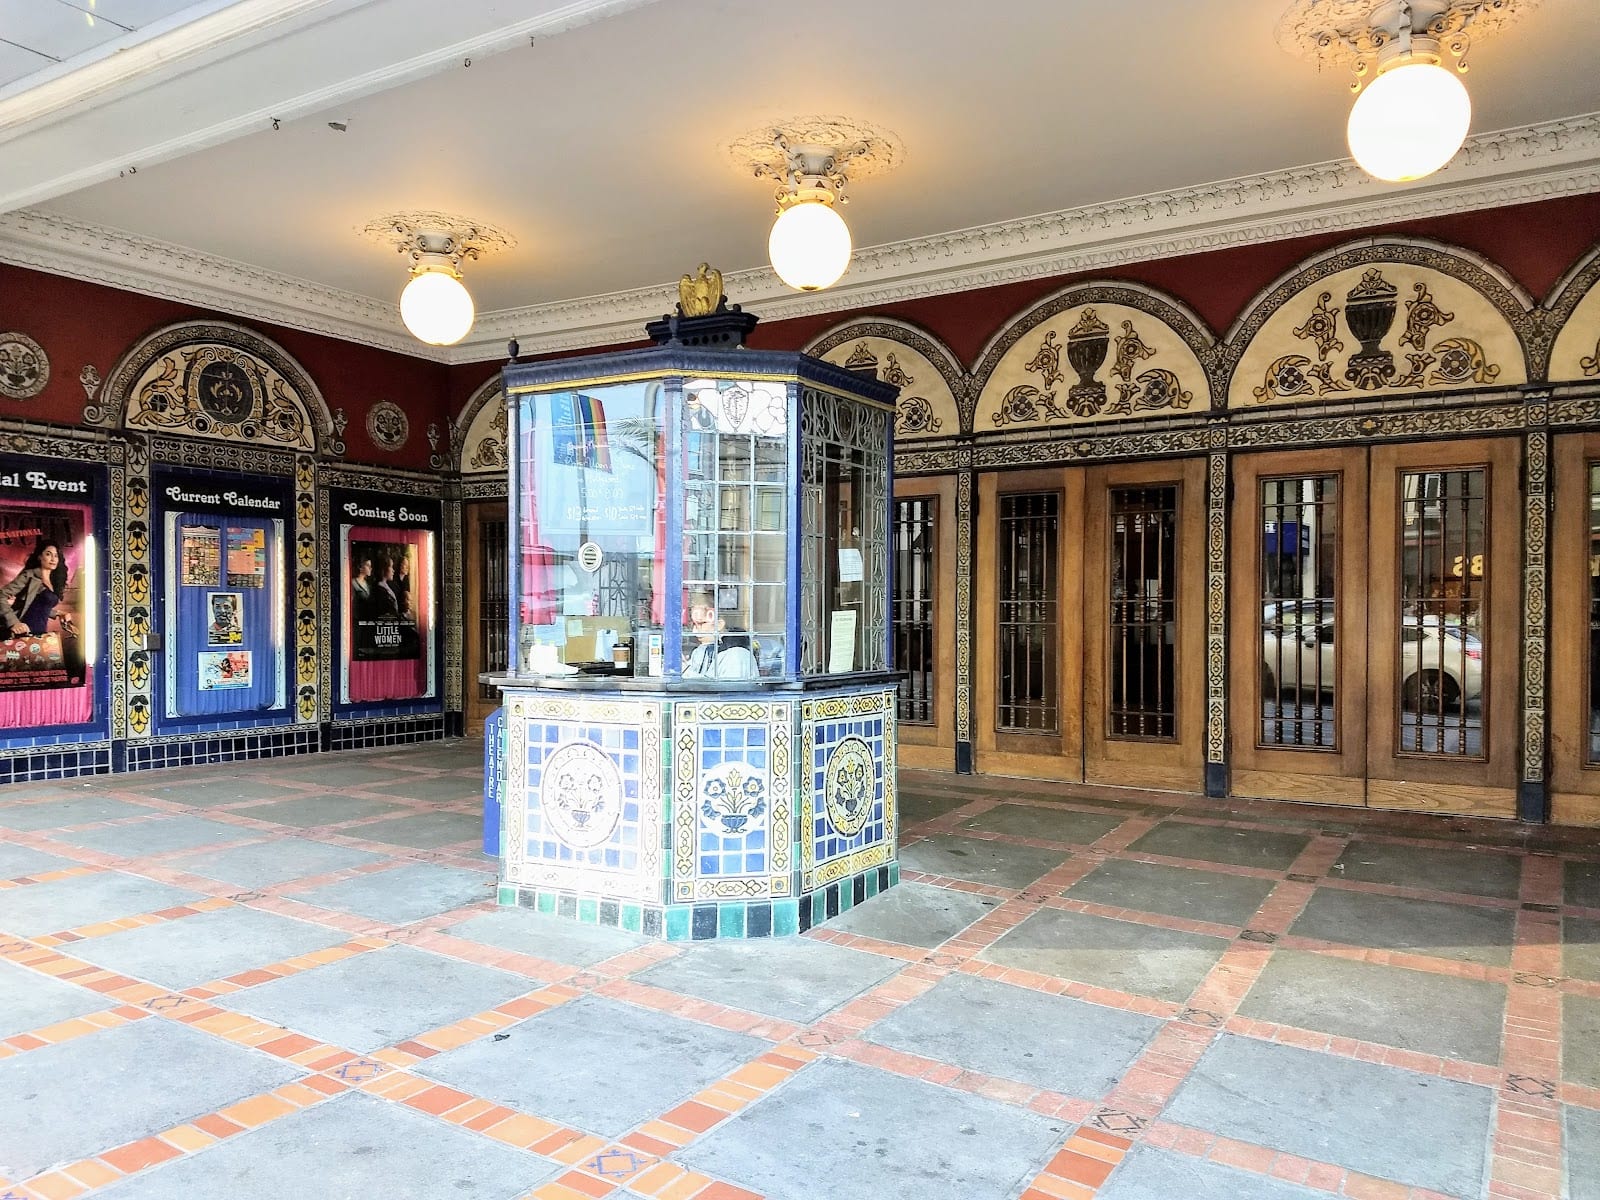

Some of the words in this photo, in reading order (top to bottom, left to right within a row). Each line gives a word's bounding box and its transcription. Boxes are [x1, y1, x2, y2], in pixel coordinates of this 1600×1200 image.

[26, 472, 87, 492] Event
[166, 486, 220, 504] Current
[223, 492, 281, 509] Calendar
[343, 502, 396, 522] Coming
[398, 507, 429, 522] Soon
[374, 635, 402, 645] WOMEN
[376, 625, 400, 636] LITTLE
[496, 716, 504, 804] CALENDAR
